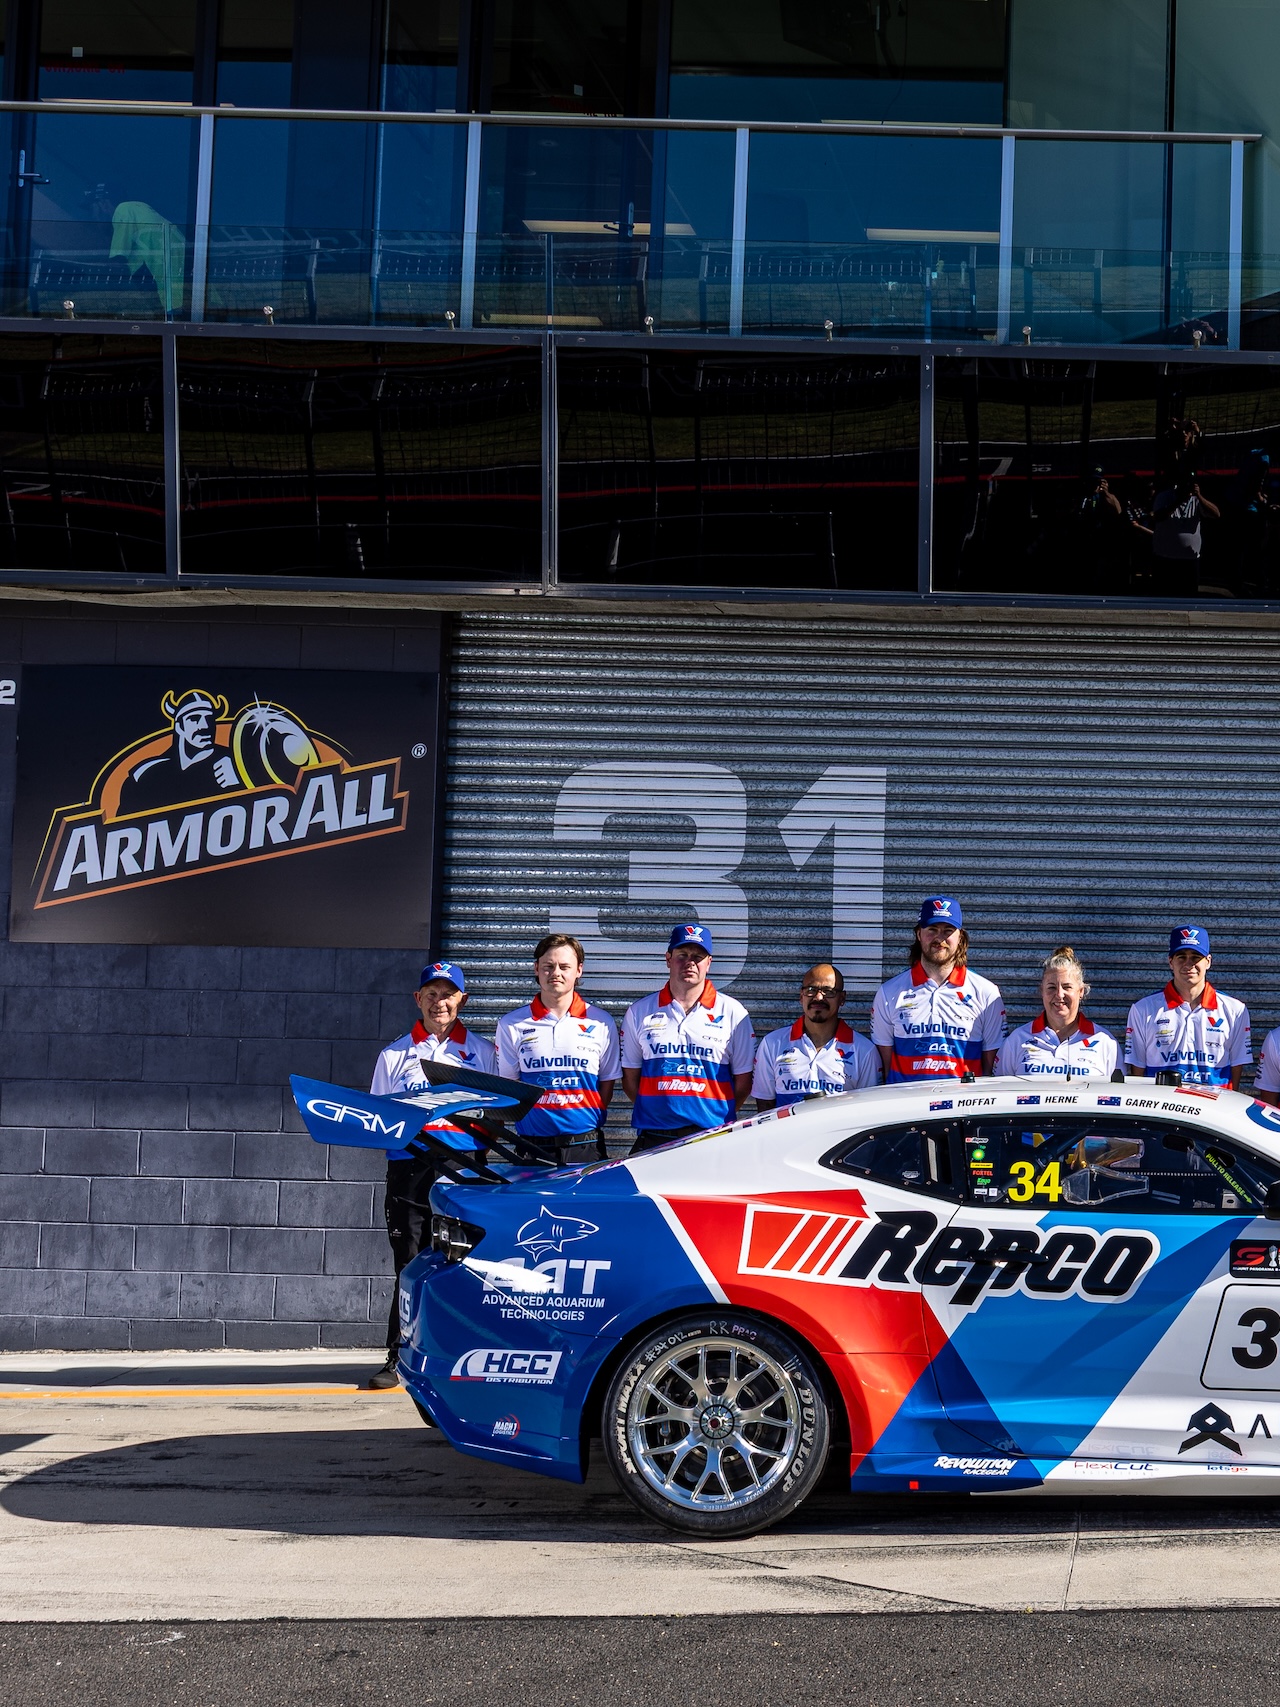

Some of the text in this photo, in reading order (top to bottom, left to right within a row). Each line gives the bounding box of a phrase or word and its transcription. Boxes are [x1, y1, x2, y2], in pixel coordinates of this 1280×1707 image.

[550, 761, 888, 992] 31
[902, 1022, 968, 1038] Valvoline
[649, 1042, 715, 1058] Valvoline
[523, 1055, 589, 1070] Valvoline
[1023, 1063, 1090, 1076] Valvoline
[668, 1079, 707, 1093] Repco
[781, 1078, 844, 1092] Valvoline
[957, 1097, 997, 1108] MOFFAT
[1044, 1095, 1079, 1105] HERNE
[1125, 1097, 1202, 1116] GARRY ROGERS
[306, 1099, 406, 1139] GRM
[1008, 1161, 1063, 1202] 34
[1223, 1172, 1246, 1197] RELEASE
[838, 1210, 1155, 1306] Repco
[482, 1294, 606, 1309] ADVANCED AQUARIUM
[500, 1308, 586, 1321] TECHNOLOGIES
[482, 1352, 553, 1375] HCC
[485, 1376, 554, 1385] DISTRIBUTION
[781, 1388, 816, 1494] DUNLOP
[933, 1456, 1018, 1470] REVOLUTION
[1074, 1460, 1154, 1471] FlexiCut
[963, 1468, 1010, 1476] RACEGEAR
